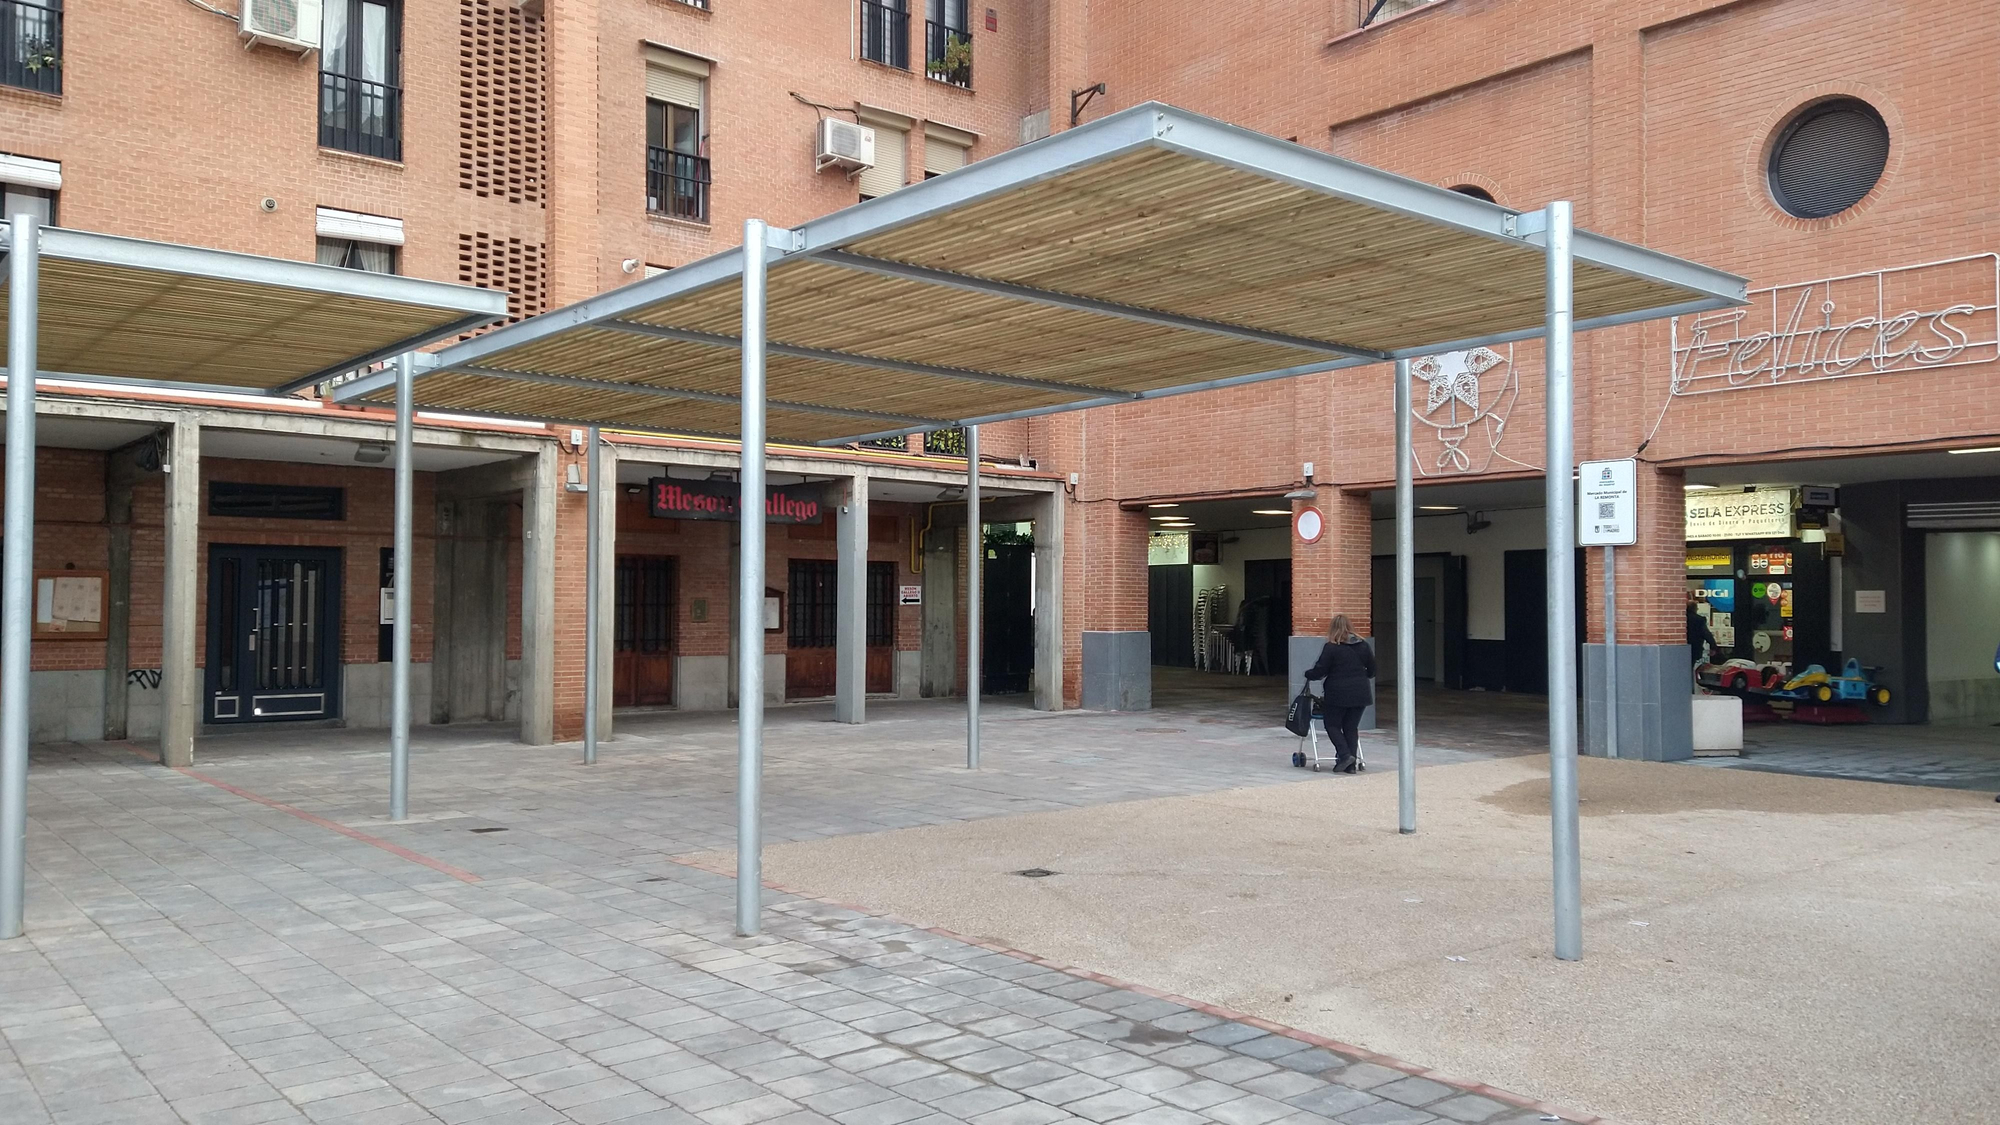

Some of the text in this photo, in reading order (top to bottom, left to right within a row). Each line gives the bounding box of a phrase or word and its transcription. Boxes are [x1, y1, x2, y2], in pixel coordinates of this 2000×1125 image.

[1676, 286, 1977, 393] Felices
[657, 484, 818, 522] Meson allego
[1689, 503, 1785, 519] SELA EXPRESS
[1695, 589, 1729, 598] DIGI
